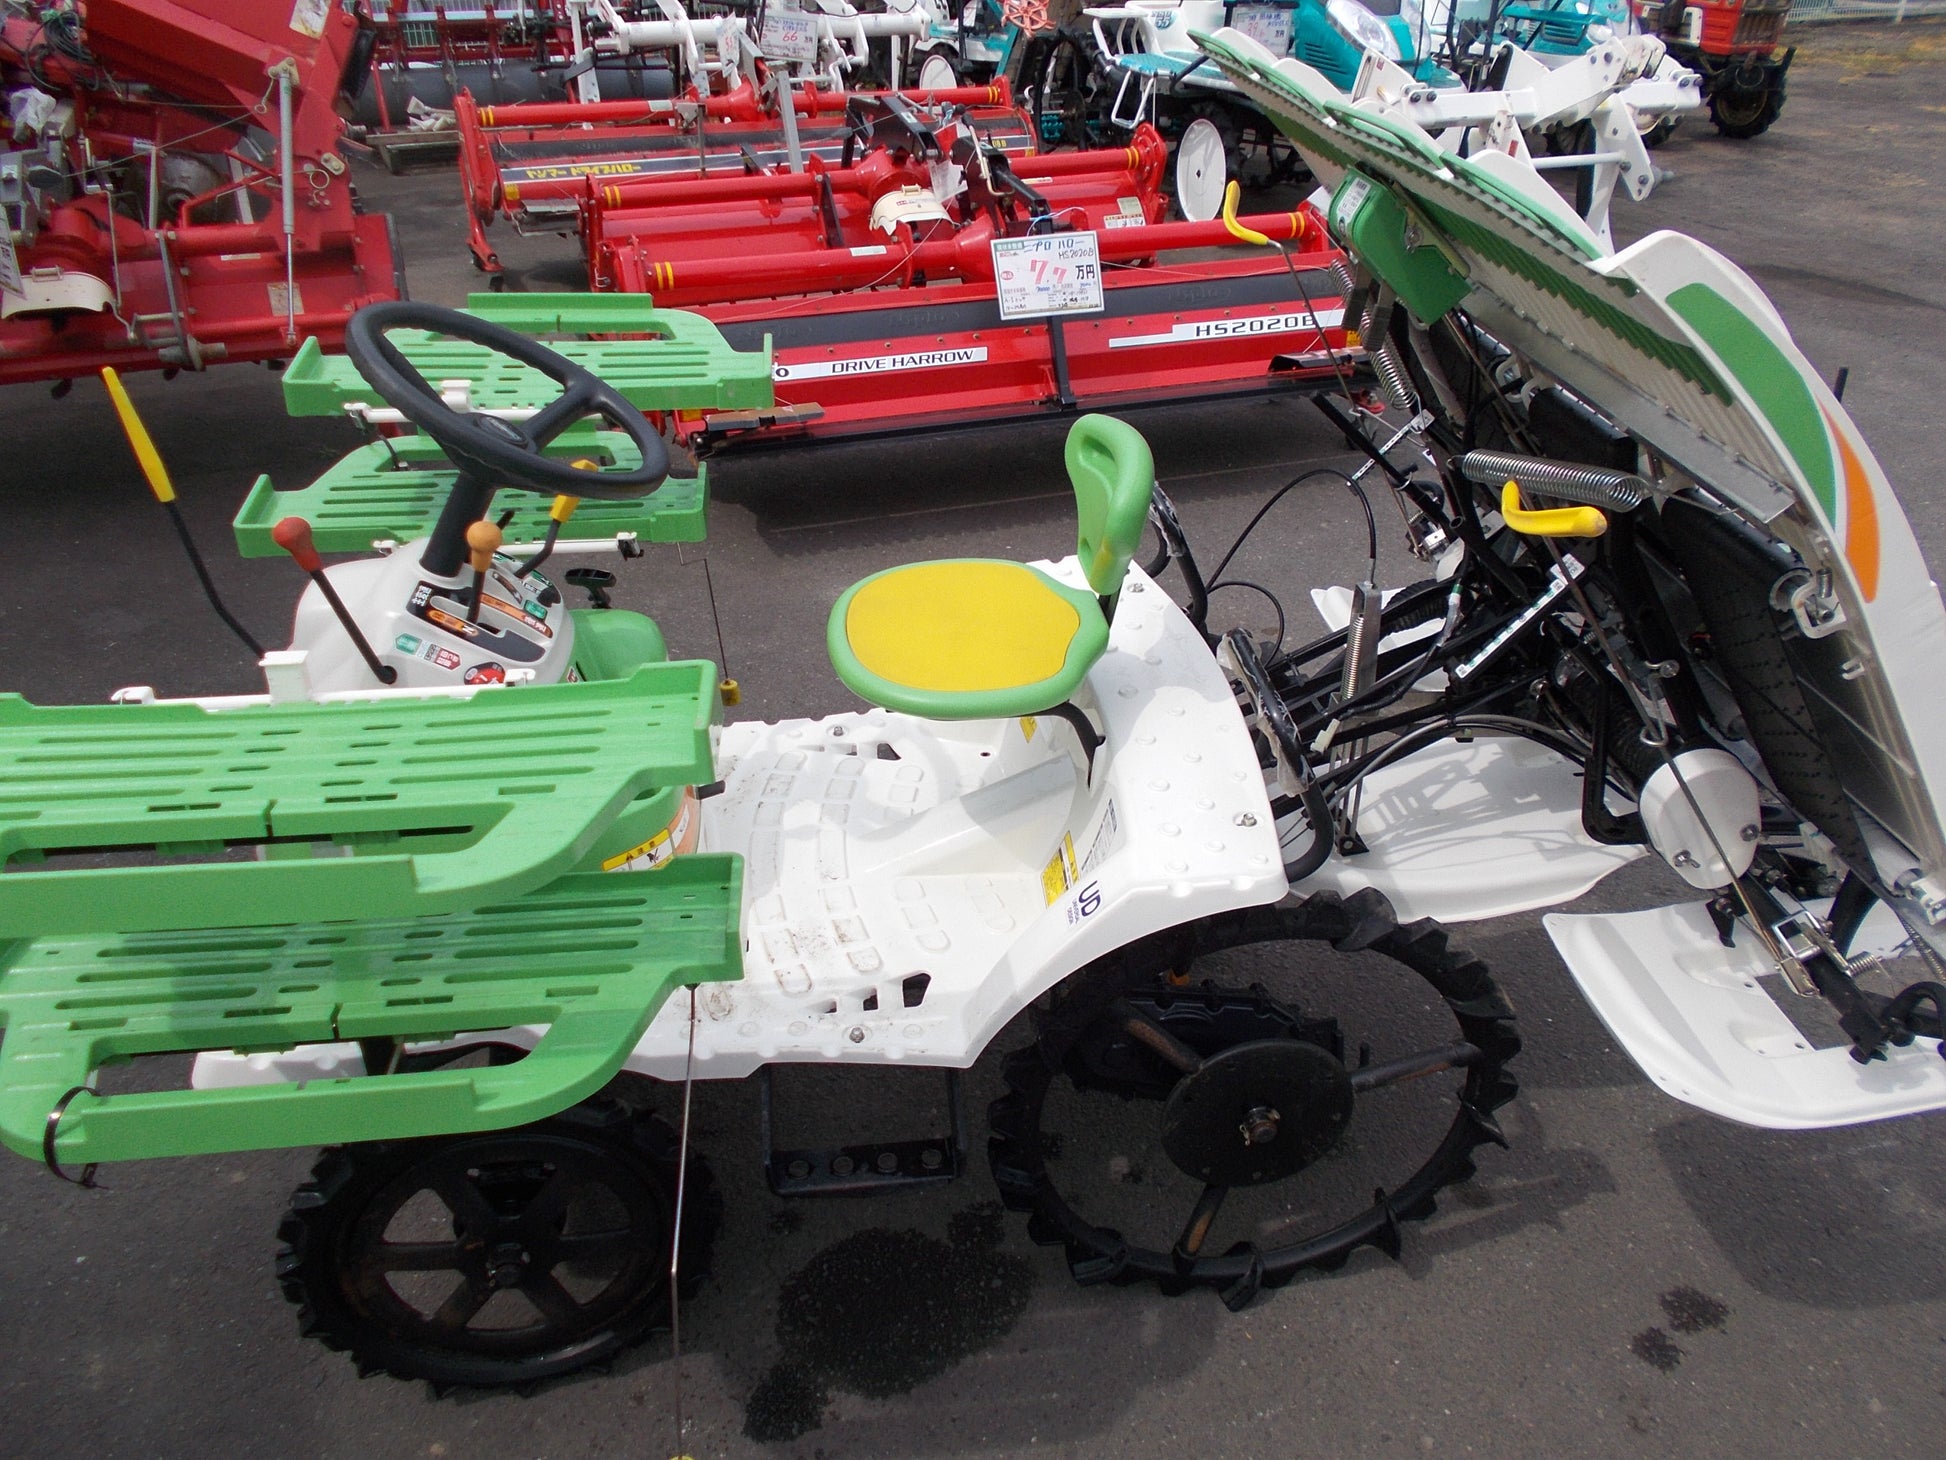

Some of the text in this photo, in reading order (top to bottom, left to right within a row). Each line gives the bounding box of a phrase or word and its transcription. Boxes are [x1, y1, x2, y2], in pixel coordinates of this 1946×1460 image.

[1075, 264, 1095, 280] 万円
[832, 358, 886, 374] DRIVE
[892, 350, 974, 368] HARROW
[1079, 880, 1101, 917] UD
